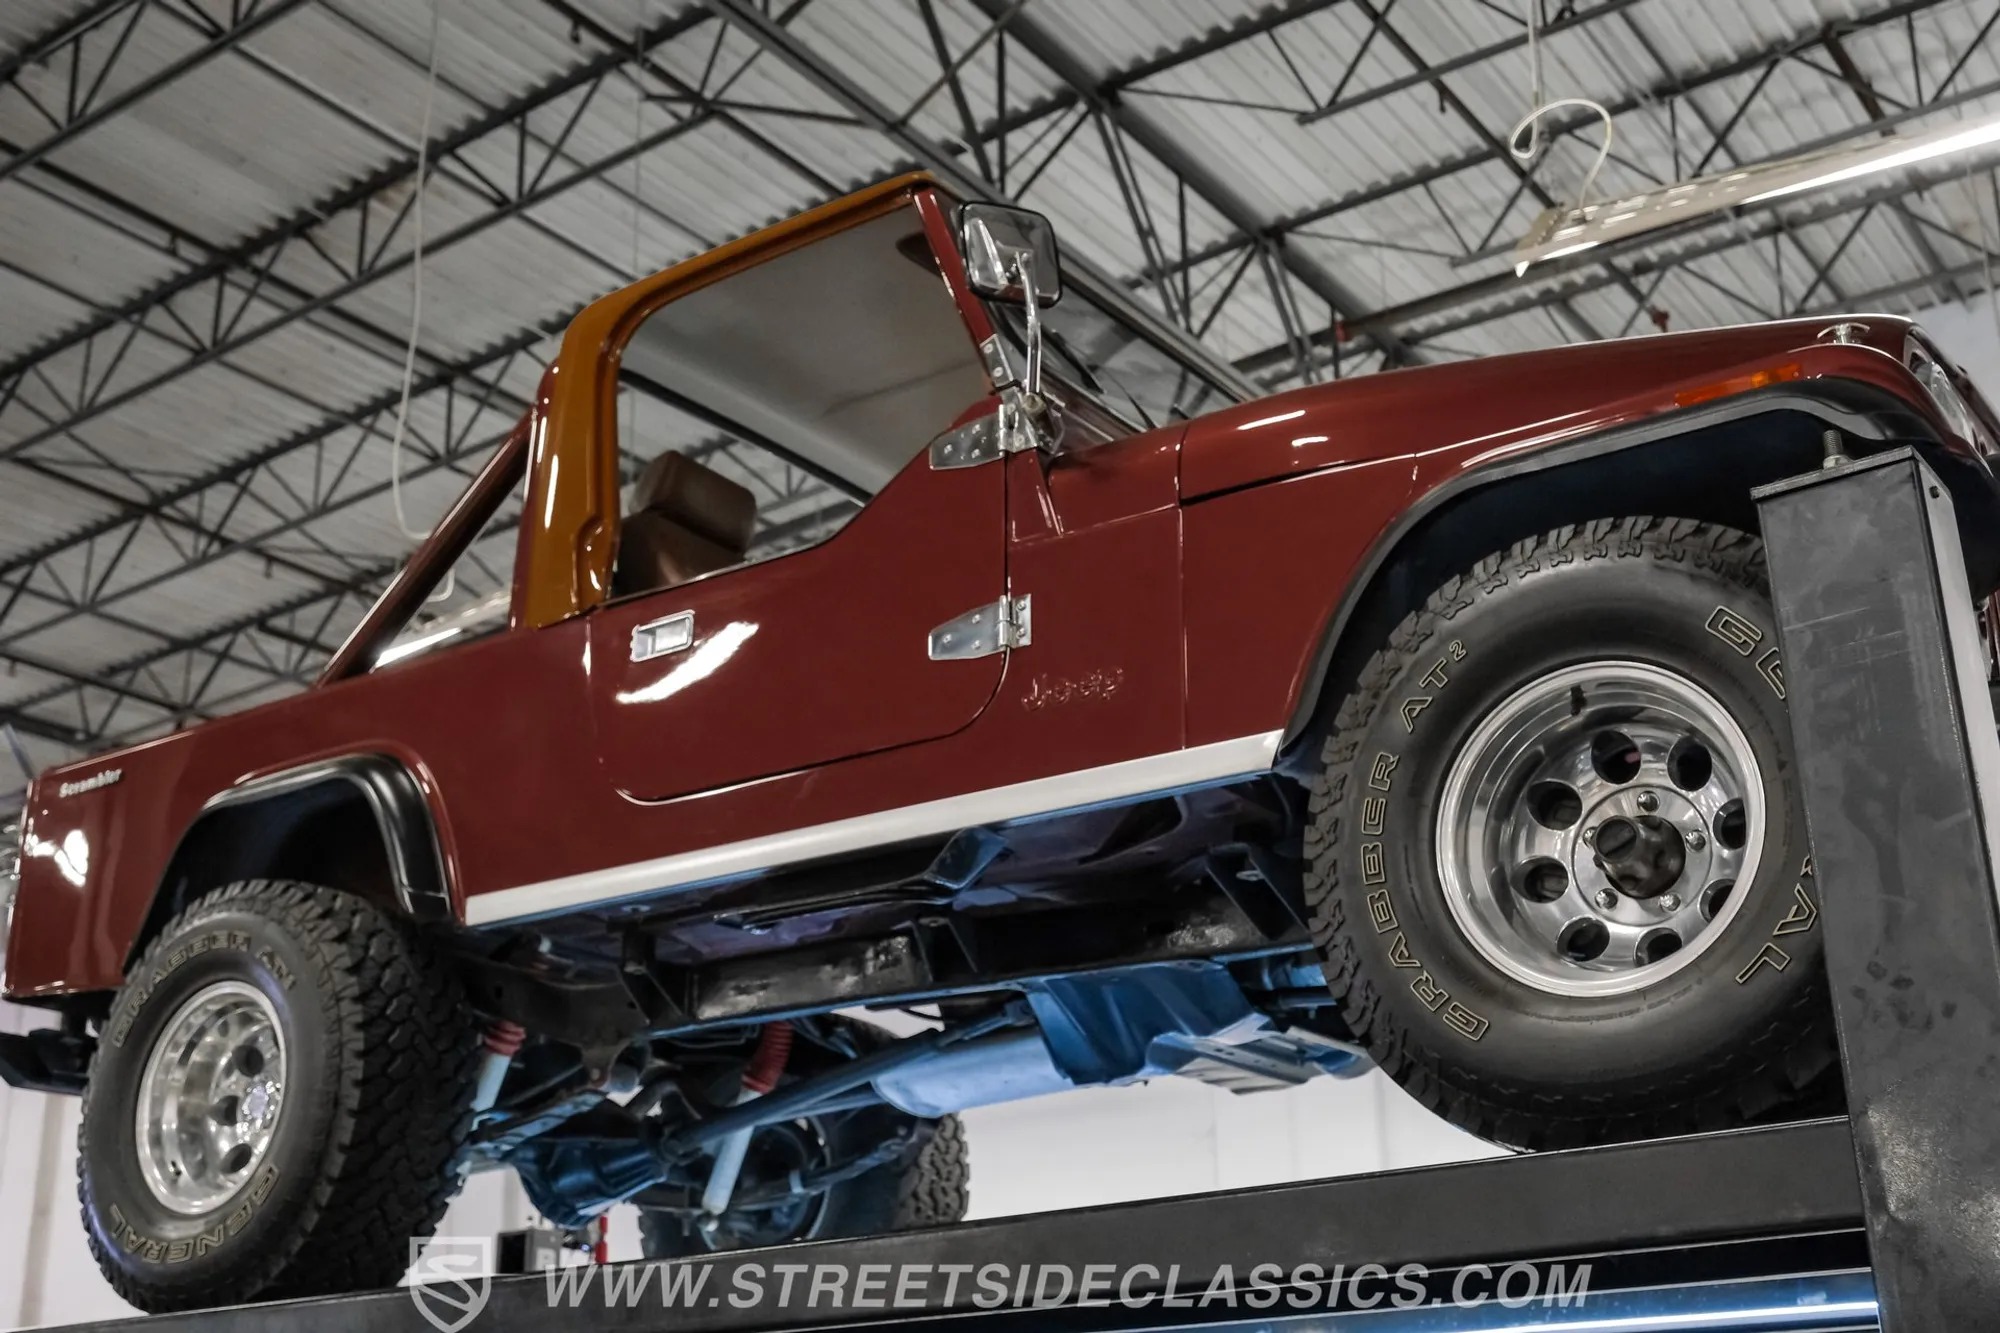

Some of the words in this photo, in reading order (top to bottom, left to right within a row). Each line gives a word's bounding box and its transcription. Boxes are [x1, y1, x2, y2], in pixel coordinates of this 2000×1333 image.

[1020, 667, 1124, 711] Jeep
[1361, 751, 1489, 1041] GRABBER
[112, 930, 252, 1048] GRABBER
[109, 1164, 280, 1264] GENERAL
